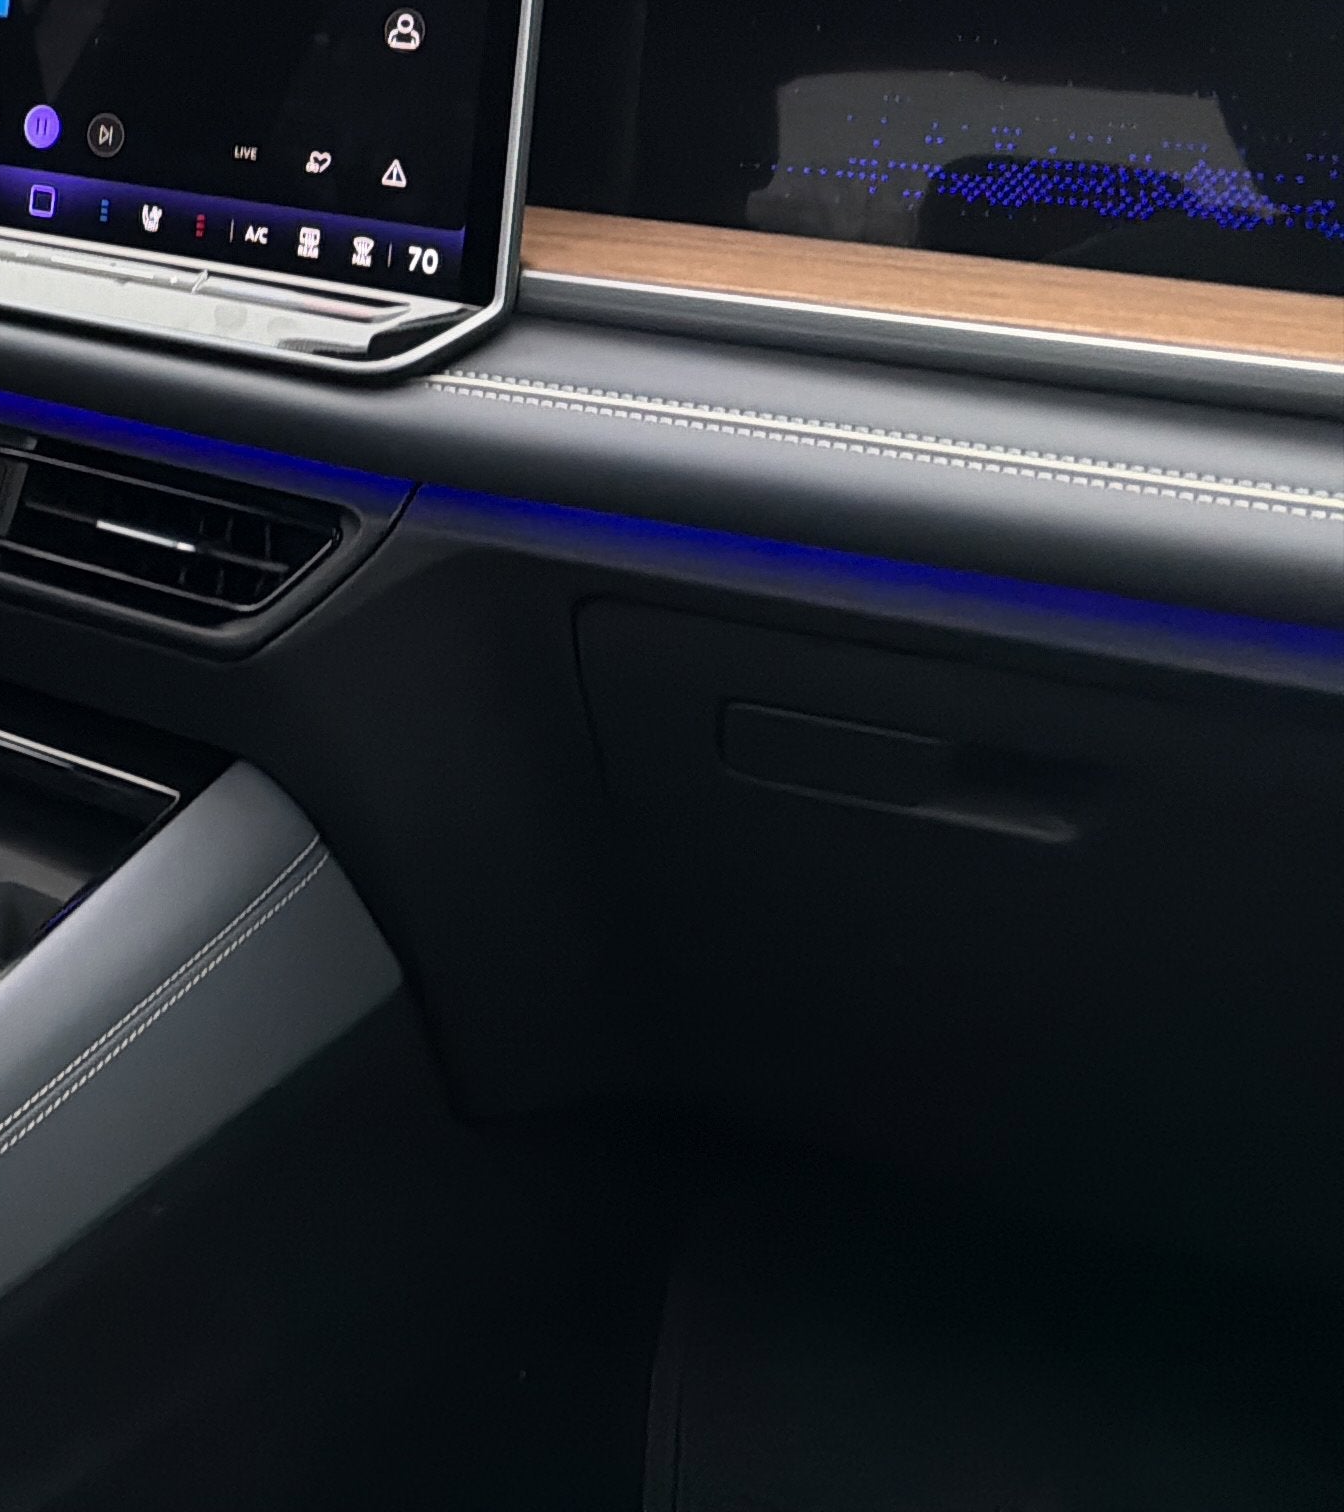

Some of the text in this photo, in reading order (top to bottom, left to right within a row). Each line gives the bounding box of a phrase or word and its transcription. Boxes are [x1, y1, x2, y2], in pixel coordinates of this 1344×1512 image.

[234, 144, 258, 161] LIVE
[244, 225, 269, 245] A/C
[408, 245, 439, 275] 70
